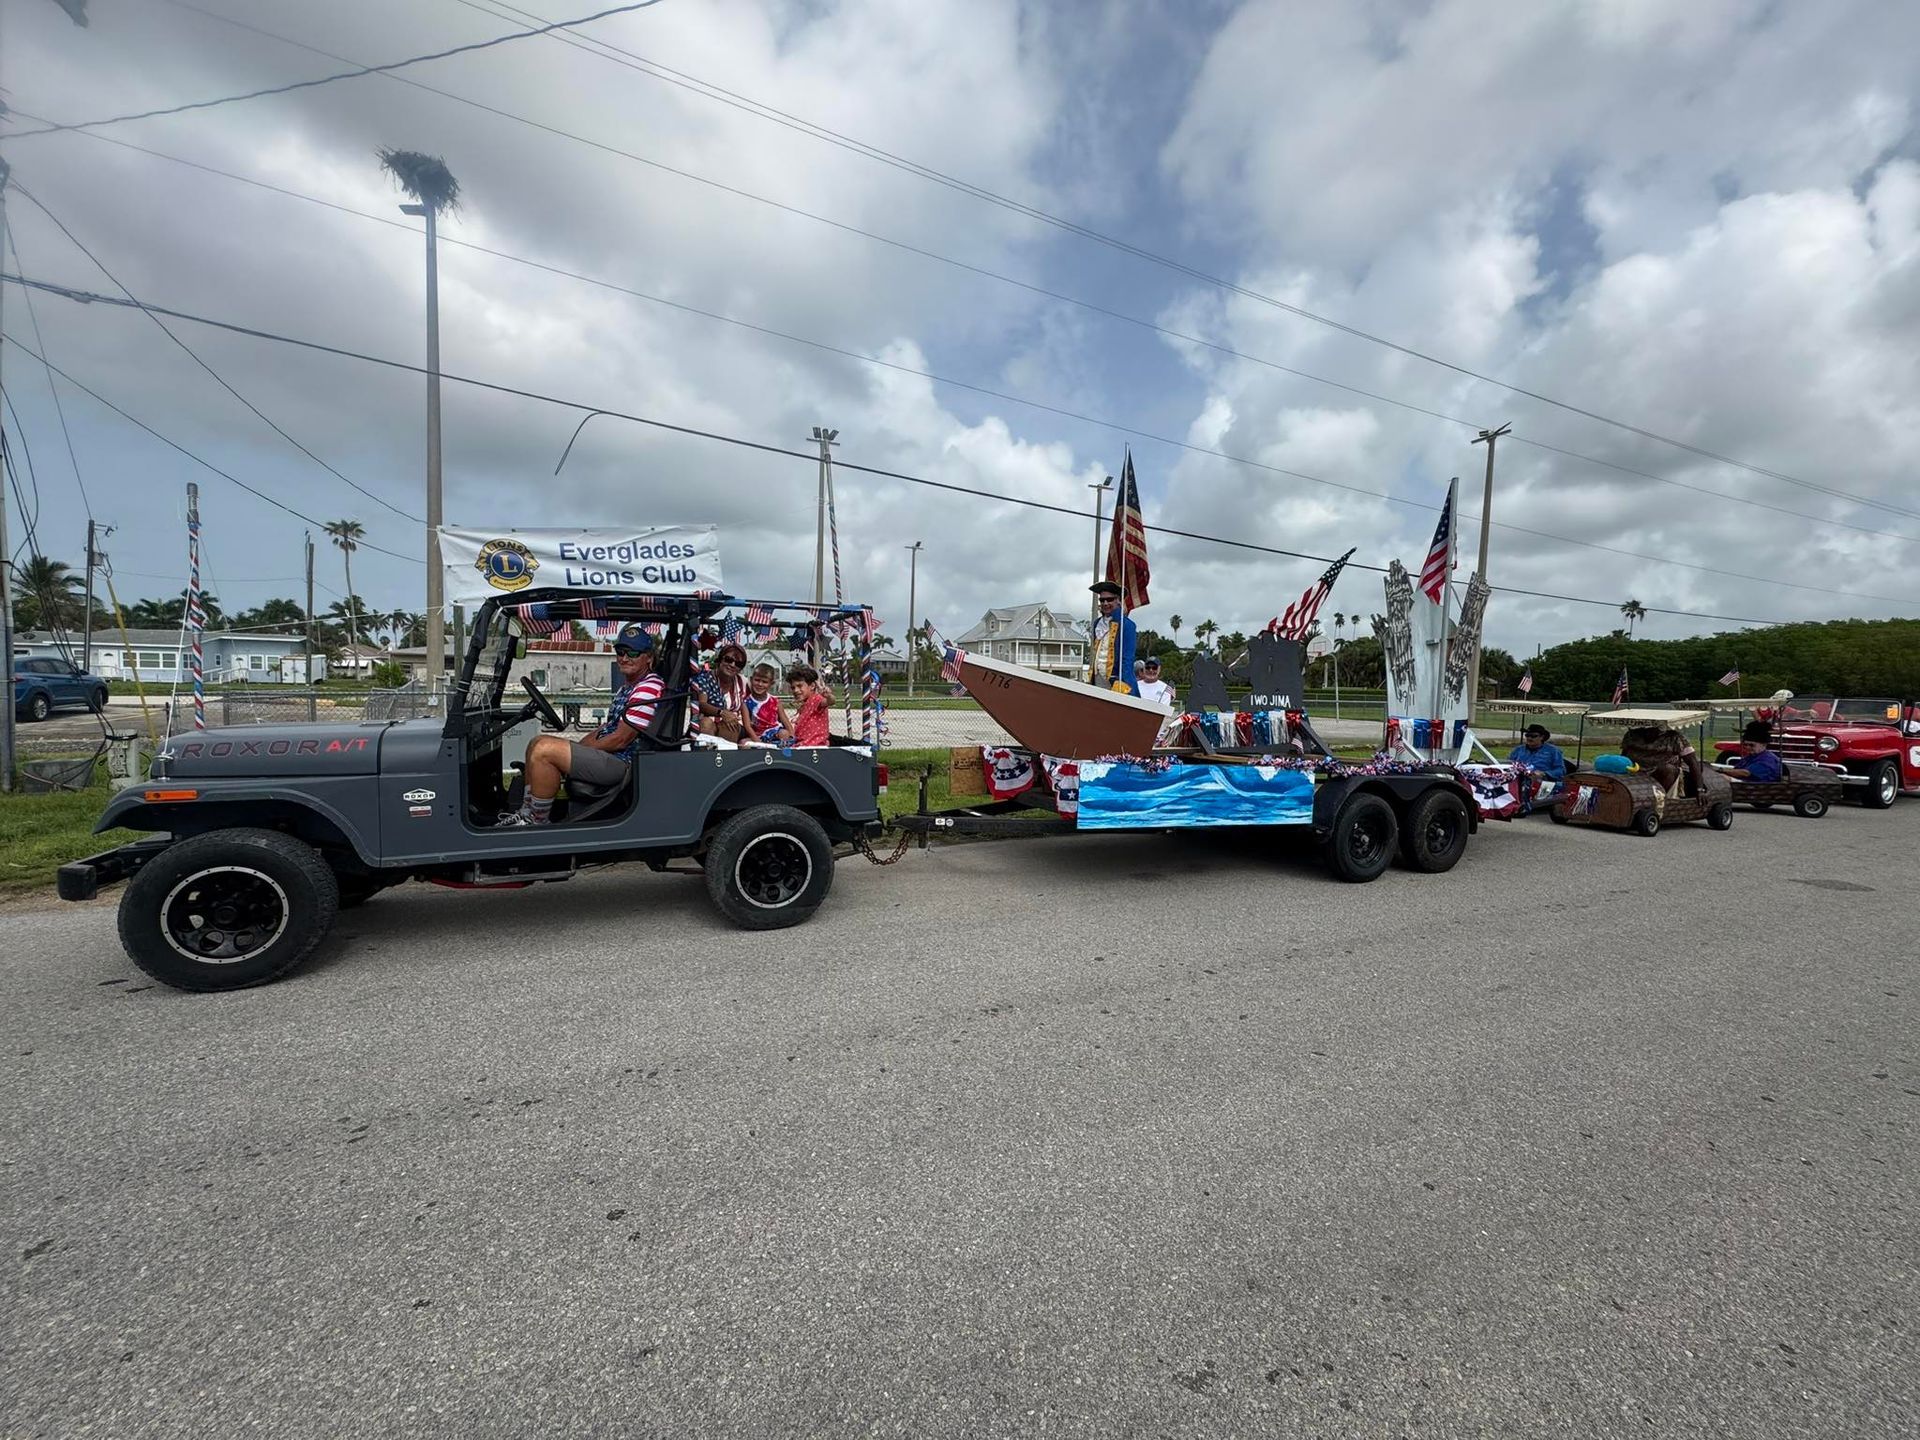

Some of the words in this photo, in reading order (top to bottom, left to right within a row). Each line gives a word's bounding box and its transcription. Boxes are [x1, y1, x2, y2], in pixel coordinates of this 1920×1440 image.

[486, 541, 524, 551] LIONS
[560, 541, 695, 564] Everglades
[566, 567, 634, 586] Lions
[642, 565, 696, 583] Club
[982, 671, 1012, 689] 1776
[1250, 694, 1268, 706] IWO
[1269, 694, 1291, 708] JIMA
[1489, 704, 1543, 715] FLINTSTONES
[181, 739, 321, 759] ROXOR
[326, 738, 369, 752] A/T
